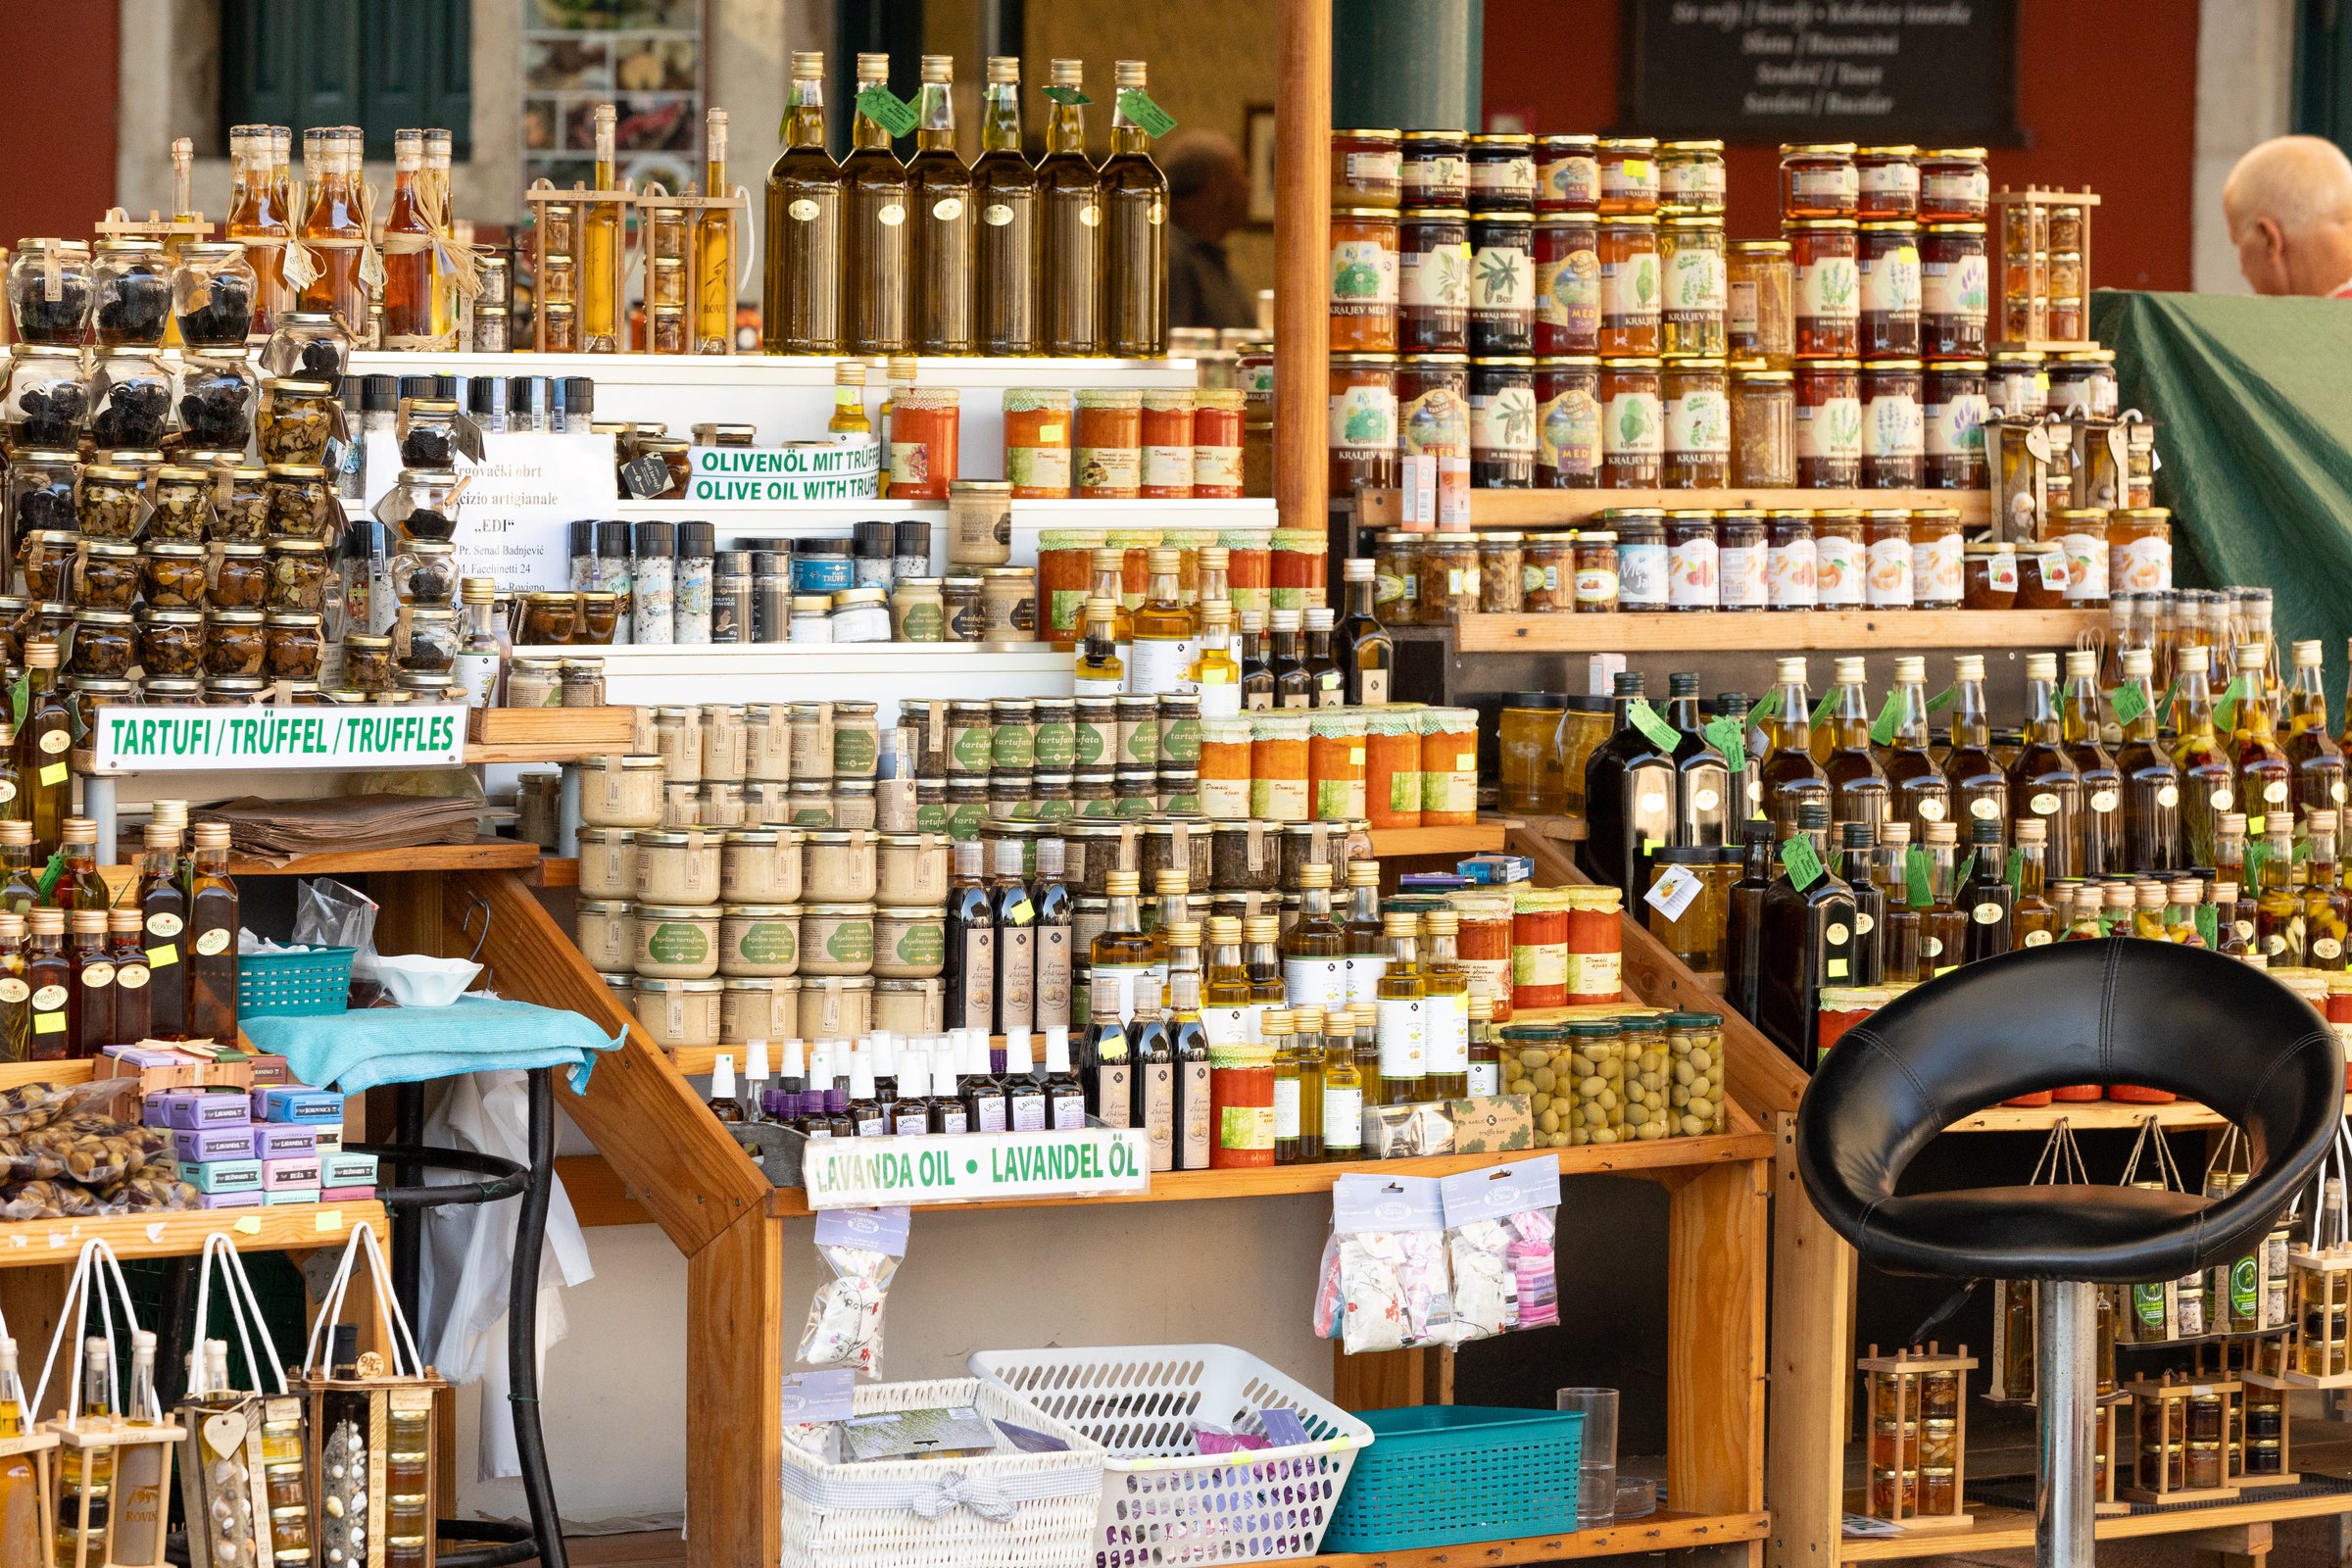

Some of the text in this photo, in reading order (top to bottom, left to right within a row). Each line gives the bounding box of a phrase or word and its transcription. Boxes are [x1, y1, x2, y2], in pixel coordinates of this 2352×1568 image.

[675, 197, 708, 206] ISTRA
[1495, 294, 1513, 304] Bor
[1330, 305, 1388, 316] KRALJEV MED
[1668, 312, 1705, 321] KRALJEV
[1339, 451, 1378, 461] KRALJEV
[1428, 448, 1454, 457] MED
[1562, 449, 1589, 458] MED
[702, 449, 808, 472] OLIVENÖL
[812, 451, 844, 471] MIT
[1608, 456, 1645, 466] KRALJEV
[1677, 454, 1714, 464] KRALJEV
[514, 465, 541, 477] obrt
[696, 479, 761, 500] OLIVE
[767, 479, 799, 500] OIL
[803, 479, 846, 500] WITH
[456, 491, 558, 509] cizio artigianale
[459, 544, 545, 558] Pr. Senad Badnjević
[458, 563, 531, 574] M. Facchinetti 24
[112, 718, 212, 755] TARTUFI
[229, 710, 327, 755] TRÜFFEL
[346, 716, 455, 753] TRUFFLES
[43, 739, 68, 750] Rovinj
[995, 737, 1034, 747] tartufata
[1038, 736, 1074, 746] tartufata
[1076, 735, 1100, 745] ufata
[151, 920, 180, 932] Rovinj
[197, 934, 224, 949] Rovinj
[2317, 945, 2340, 955] Rovinj
[85, 971, 112, 983] Rovinj
[121, 971, 146, 982] Rovinj
[34, 989, 61, 1002] Rovinj
[214, 1108, 236, 1117] LAVANDA
[897, 1116, 925, 1128] LAVANDA
[1479, 1128, 1495, 1137] truffle
[816, 1133, 1139, 1194] LAVANDA OIL LAVANDEL ÖL
[845, 1297, 878, 1312] Rovin
